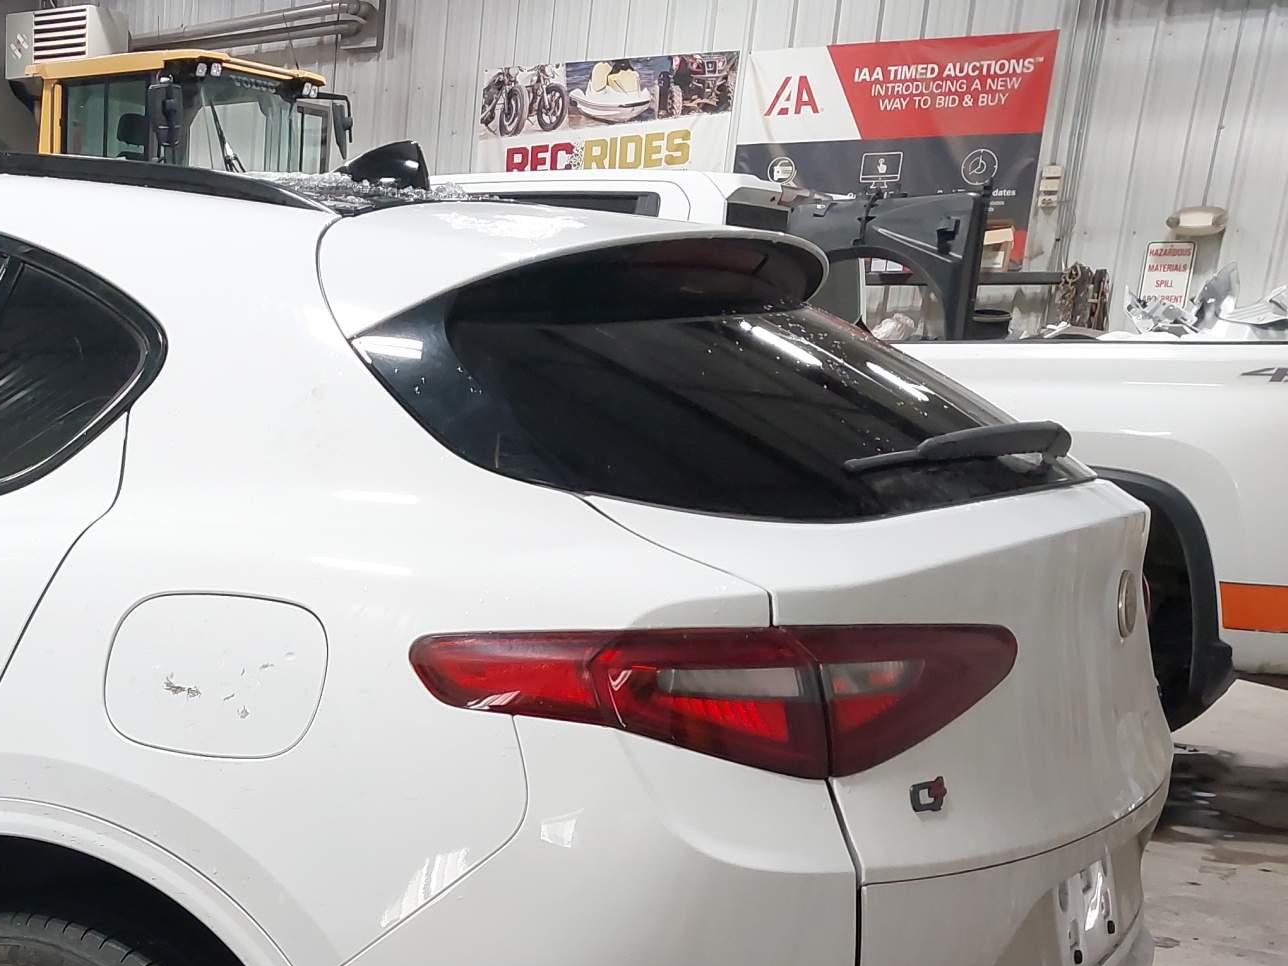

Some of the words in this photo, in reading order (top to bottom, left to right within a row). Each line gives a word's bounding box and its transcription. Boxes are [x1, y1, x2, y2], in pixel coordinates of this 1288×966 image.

[854, 67, 884, 82] IAA
[887, 63, 939, 80] TIMED
[871, 79, 967, 97] INTRODUCING
[970, 79, 982, 91] A
[985, 77, 1022, 91] NEW
[879, 97, 910, 111] WAY
[913, 95, 931, 109] TO
[935, 95, 959, 108] BID
[962, 94, 974, 107] &
[978, 93, 1009, 107] BUY
[583, 129, 692, 170] RIDES
[1149, 248, 1192, 256] HAZARDOUS
[1147, 263, 1188, 272] MATERIALS
[1154, 279, 1173, 288] SPILL
